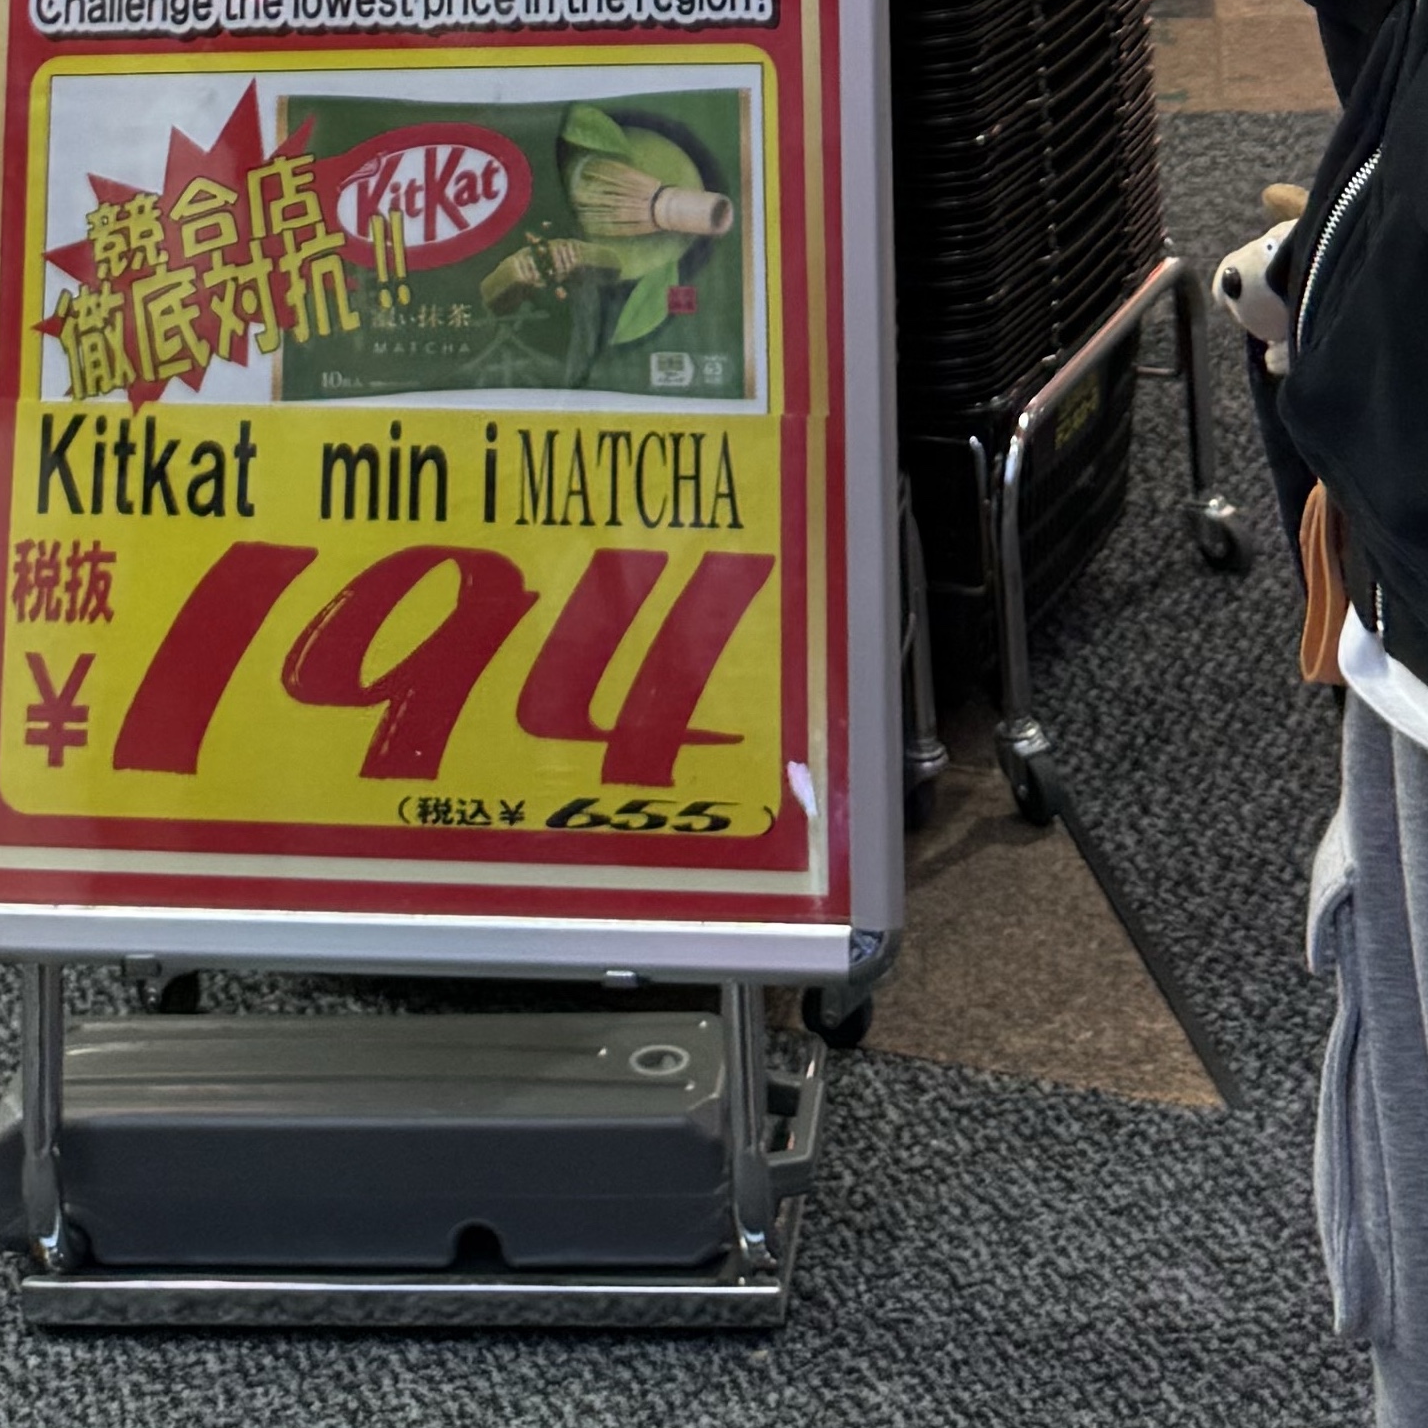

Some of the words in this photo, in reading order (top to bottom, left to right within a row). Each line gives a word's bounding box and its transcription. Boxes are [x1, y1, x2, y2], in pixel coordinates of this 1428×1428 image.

[86, 151, 320, 275] 競合店
[335, 144, 510, 250] KitKat
[373, 341, 471, 354] MATCHA
[34, 413, 258, 518] Kitkat
[516, 429, 745, 531] MATCHA
[12, 538, 117, 625] 税抜
